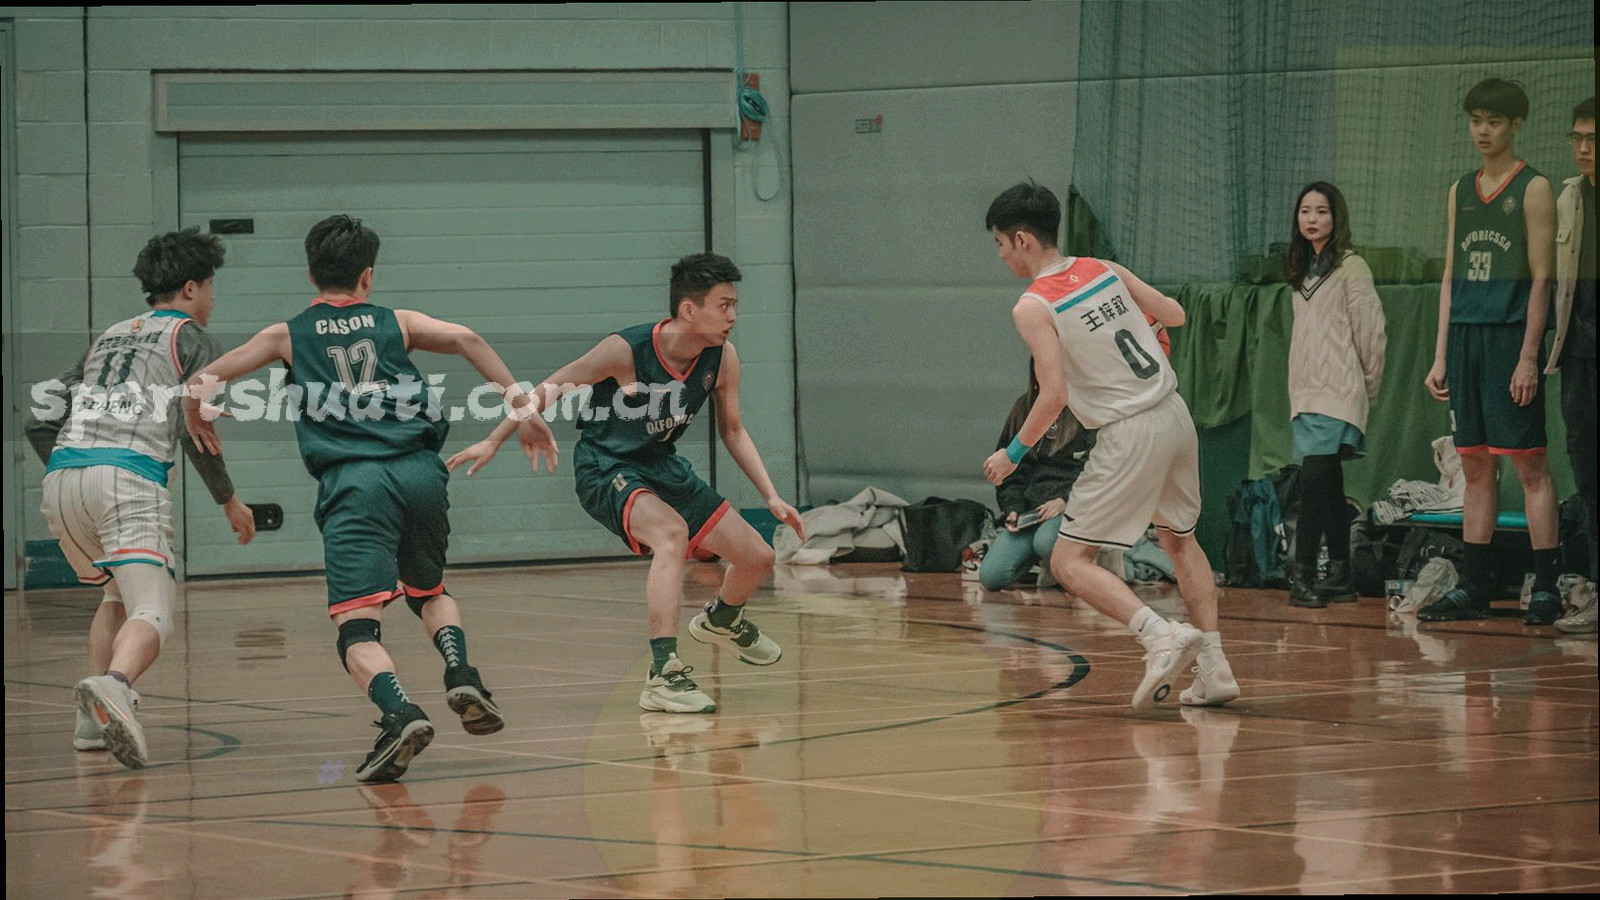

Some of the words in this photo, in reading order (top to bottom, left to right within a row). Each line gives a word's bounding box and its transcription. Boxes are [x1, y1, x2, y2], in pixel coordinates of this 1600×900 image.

[1467, 250, 1493, 282] 33
[315, 314, 376, 335] CASON
[1080, 295, 1129, 333] 王梓叙
[326, 338, 390, 397] 12
[1114, 328, 1161, 380] 0
